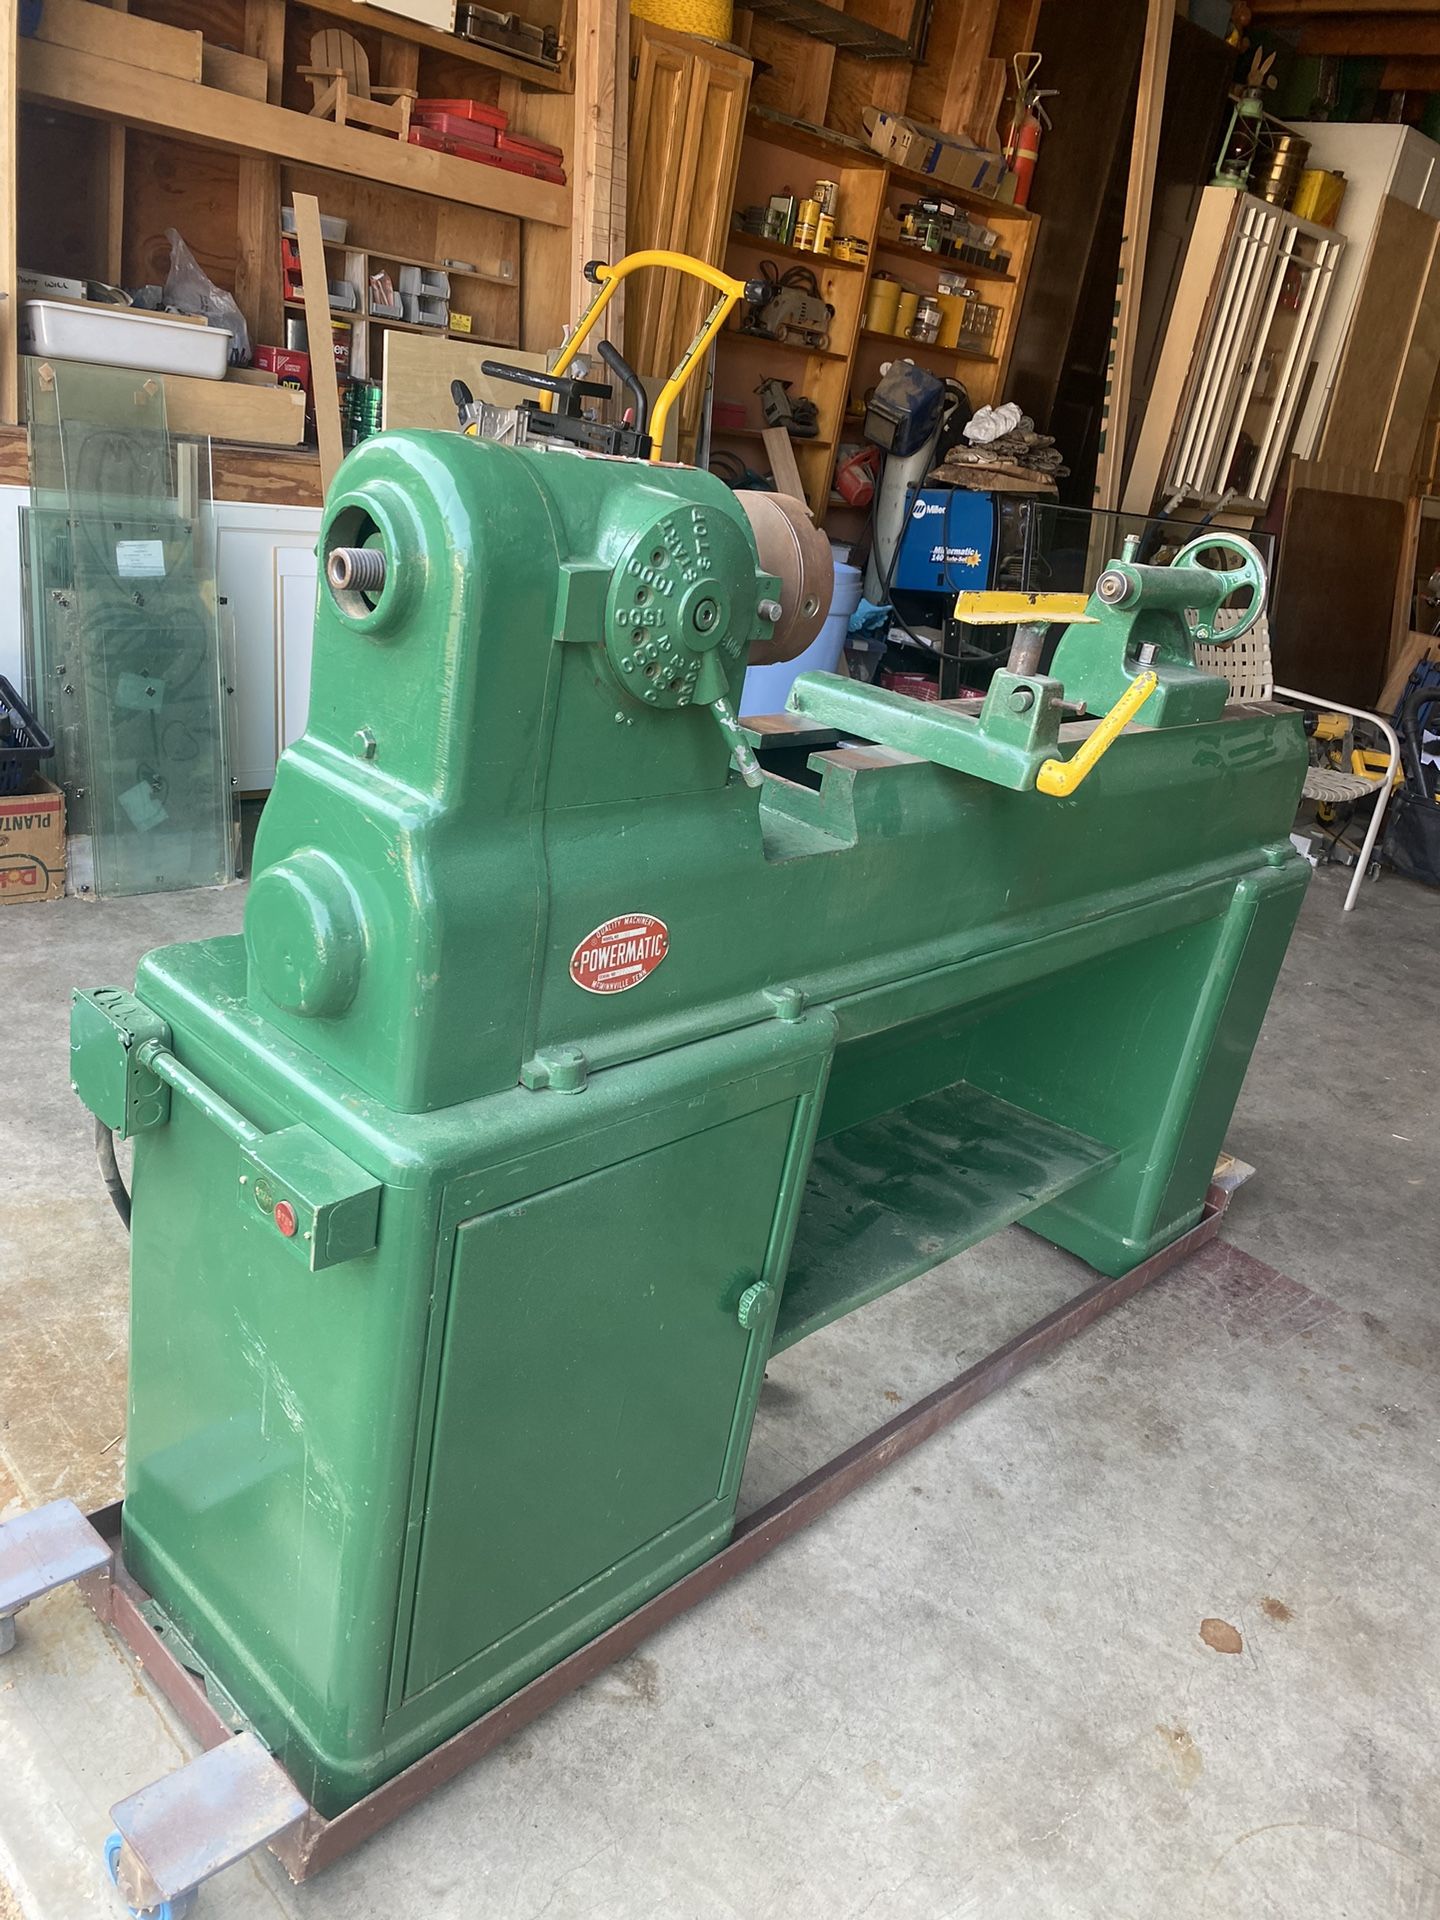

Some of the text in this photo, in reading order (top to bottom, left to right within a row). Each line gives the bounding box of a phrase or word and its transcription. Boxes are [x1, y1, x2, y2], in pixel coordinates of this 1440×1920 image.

[926, 504, 946, 514] Miller
[657, 519, 697, 583] START
[691, 507, 712, 570] STOP
[627, 557, 675, 597] 1000
[615, 607, 665, 627] 1500
[620, 634, 672, 673] 2000
[0, 870, 36, 888] Dol
[597, 921, 621, 938] QUALITY
[624, 916, 655, 927] MACHINERY
[580, 934, 663, 975] POWERMATIC
